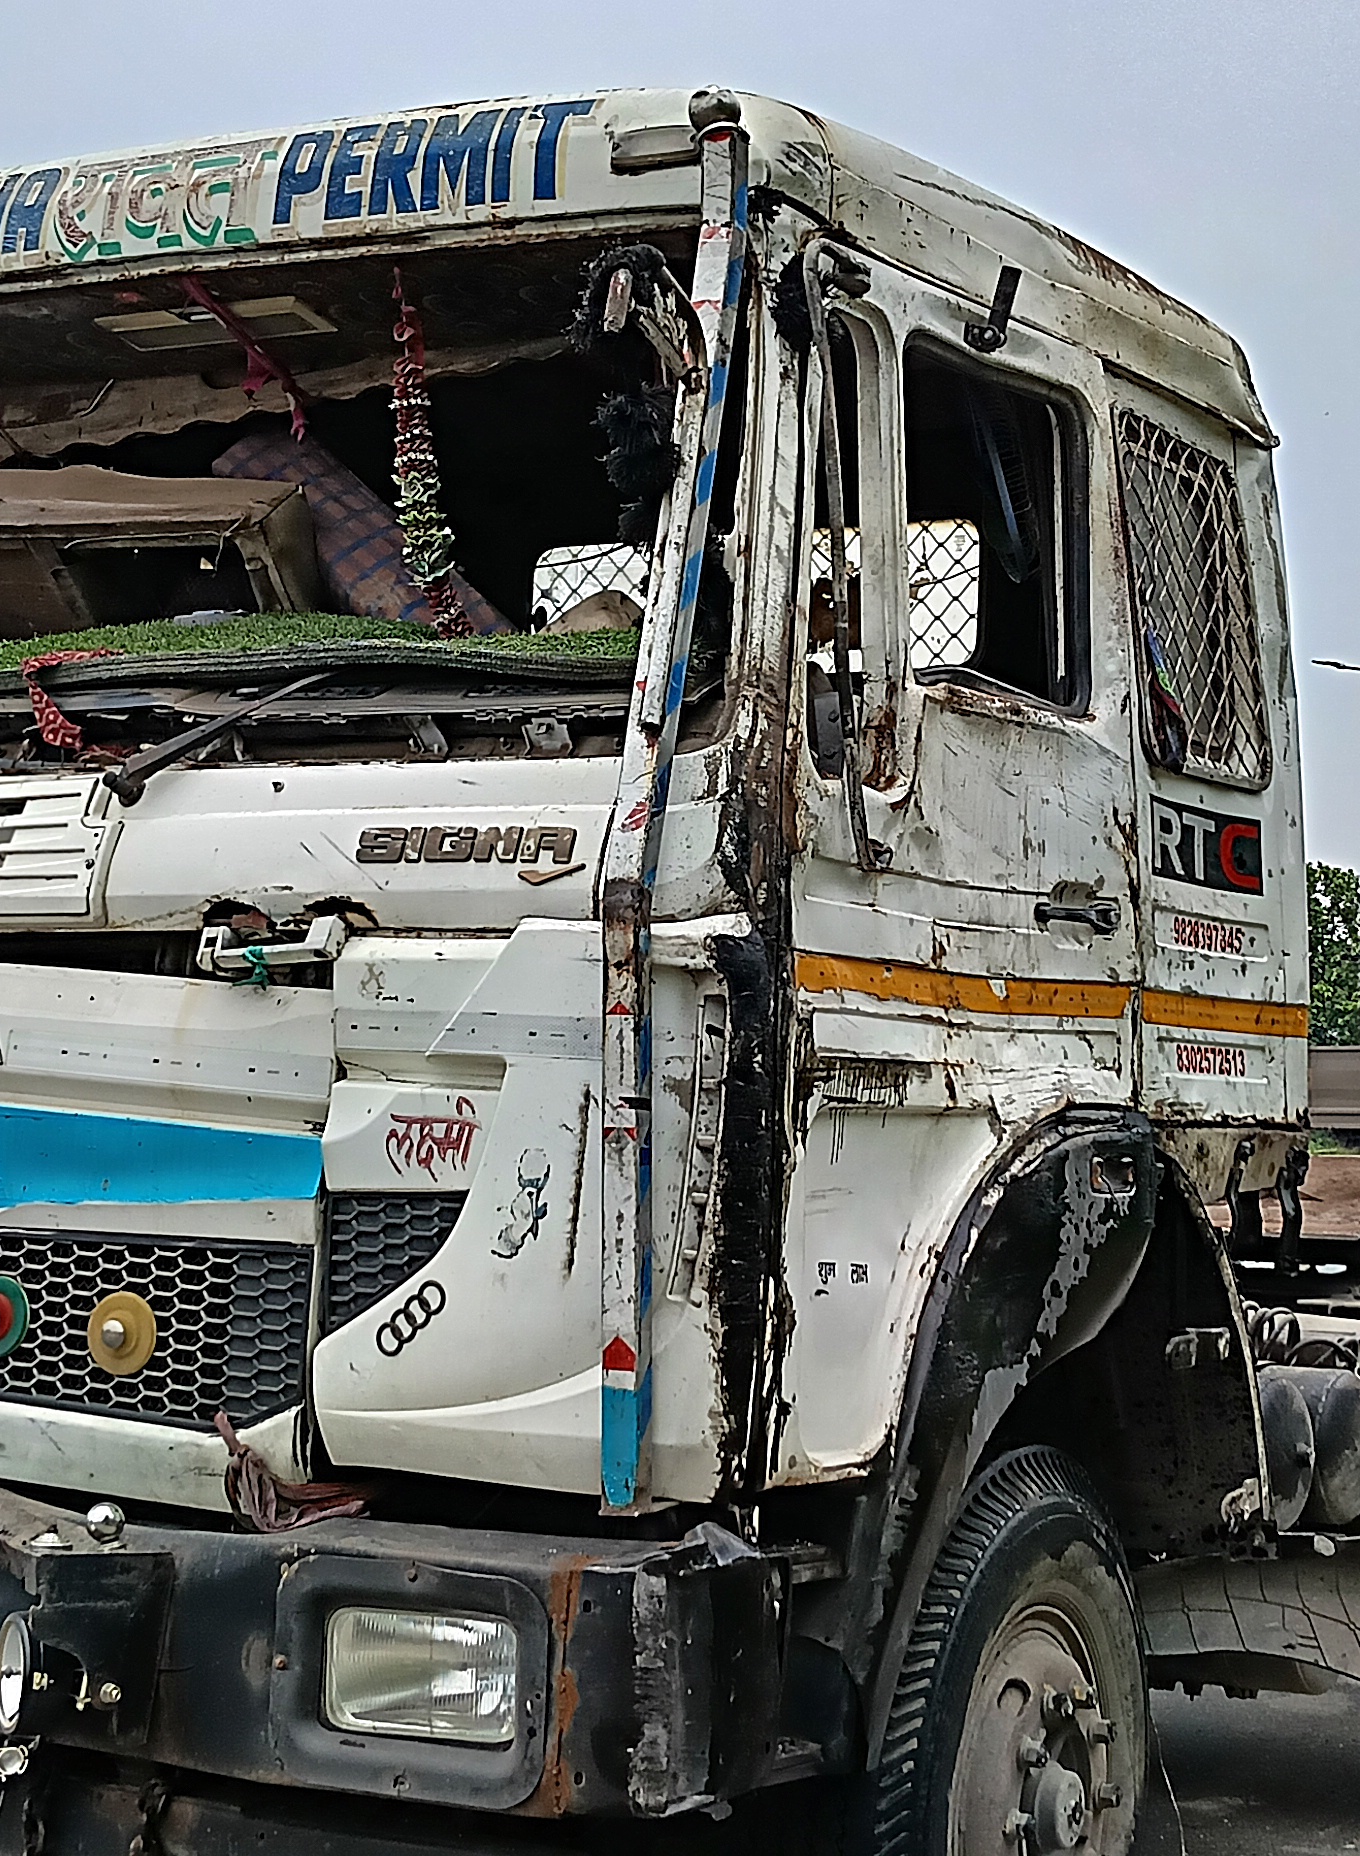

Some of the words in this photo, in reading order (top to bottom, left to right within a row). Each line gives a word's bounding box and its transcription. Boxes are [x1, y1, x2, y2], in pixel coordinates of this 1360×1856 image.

[272, 99, 600, 226] PERMIT
[356, 826, 578, 864] SIGNA
[1152, 801, 1260, 890] RTC
[1176, 1044, 1246, 1077] 8302572513
